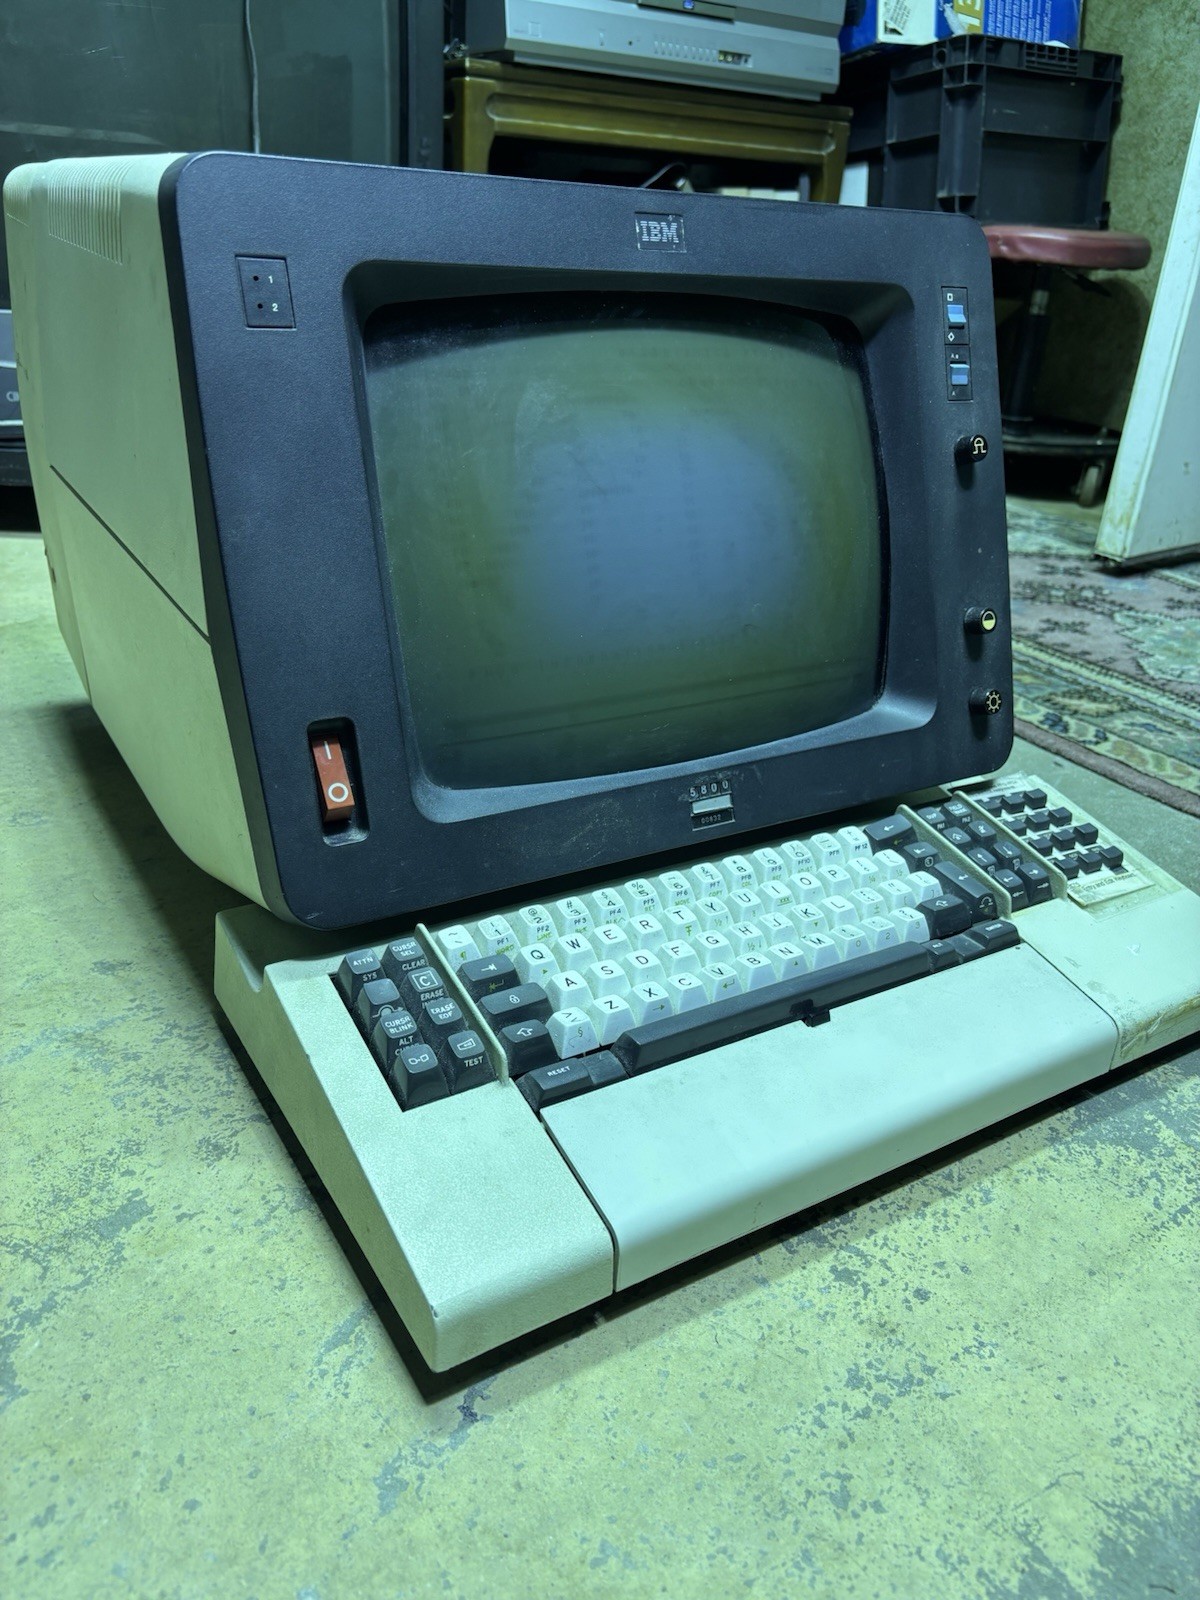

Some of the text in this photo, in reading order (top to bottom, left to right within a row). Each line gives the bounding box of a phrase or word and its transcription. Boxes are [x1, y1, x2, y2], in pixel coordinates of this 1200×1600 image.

[640, 221, 679, 243] IBM
[268, 275, 274, 284] 1
[271, 303, 279, 312] 2
[689, 780, 729, 797] 5800
[827, 869, 838, 879] P
[799, 877, 812, 886] O
[738, 893, 752, 904] U
[705, 902, 717, 912] Y
[830, 901, 845, 909] L
[673, 910, 685, 921] T
[800, 908, 816, 918] K
[574, 917, 587, 926] PF3
[639, 919, 654, 930] R
[773, 918, 782, 927] J
[536, 925, 550, 934] PF2
[738, 926, 753, 936] H
[603, 929, 618, 941] E
[497, 937, 510, 946] PF1
[566, 938, 581, 950] W
[705, 936, 720, 945] G
[809, 937, 826, 946] M
[391, 941, 417, 952] CURSR
[671, 946, 680, 956] F
[778, 947, 794, 956] N
[530, 949, 545, 960] Q
[353, 956, 374, 967] ATTN
[402, 959, 426, 971] CLEAR
[635, 955, 649, 965] D
[746, 957, 761, 966] B
[601, 966, 614, 975] S
[711, 967, 725, 976] V
[362, 971, 378, 981] SYS
[419, 975, 431, 987] C
[565, 977, 578, 987] A
[678, 978, 692, 987] C
[420, 989, 444, 1001] ERASE
[643, 988, 659, 998] X
[430, 1002, 455, 1014] ERASE
[604, 1000, 619, 1010] Z
[438, 1011, 453, 1020] EOF
[384, 1016, 411, 1028] CURSR
[388, 1023, 414, 1034] BLINK
[399, 1035, 414, 1046] ALT
[464, 1056, 484, 1067] TEST
[547, 1065, 571, 1077] RESET
